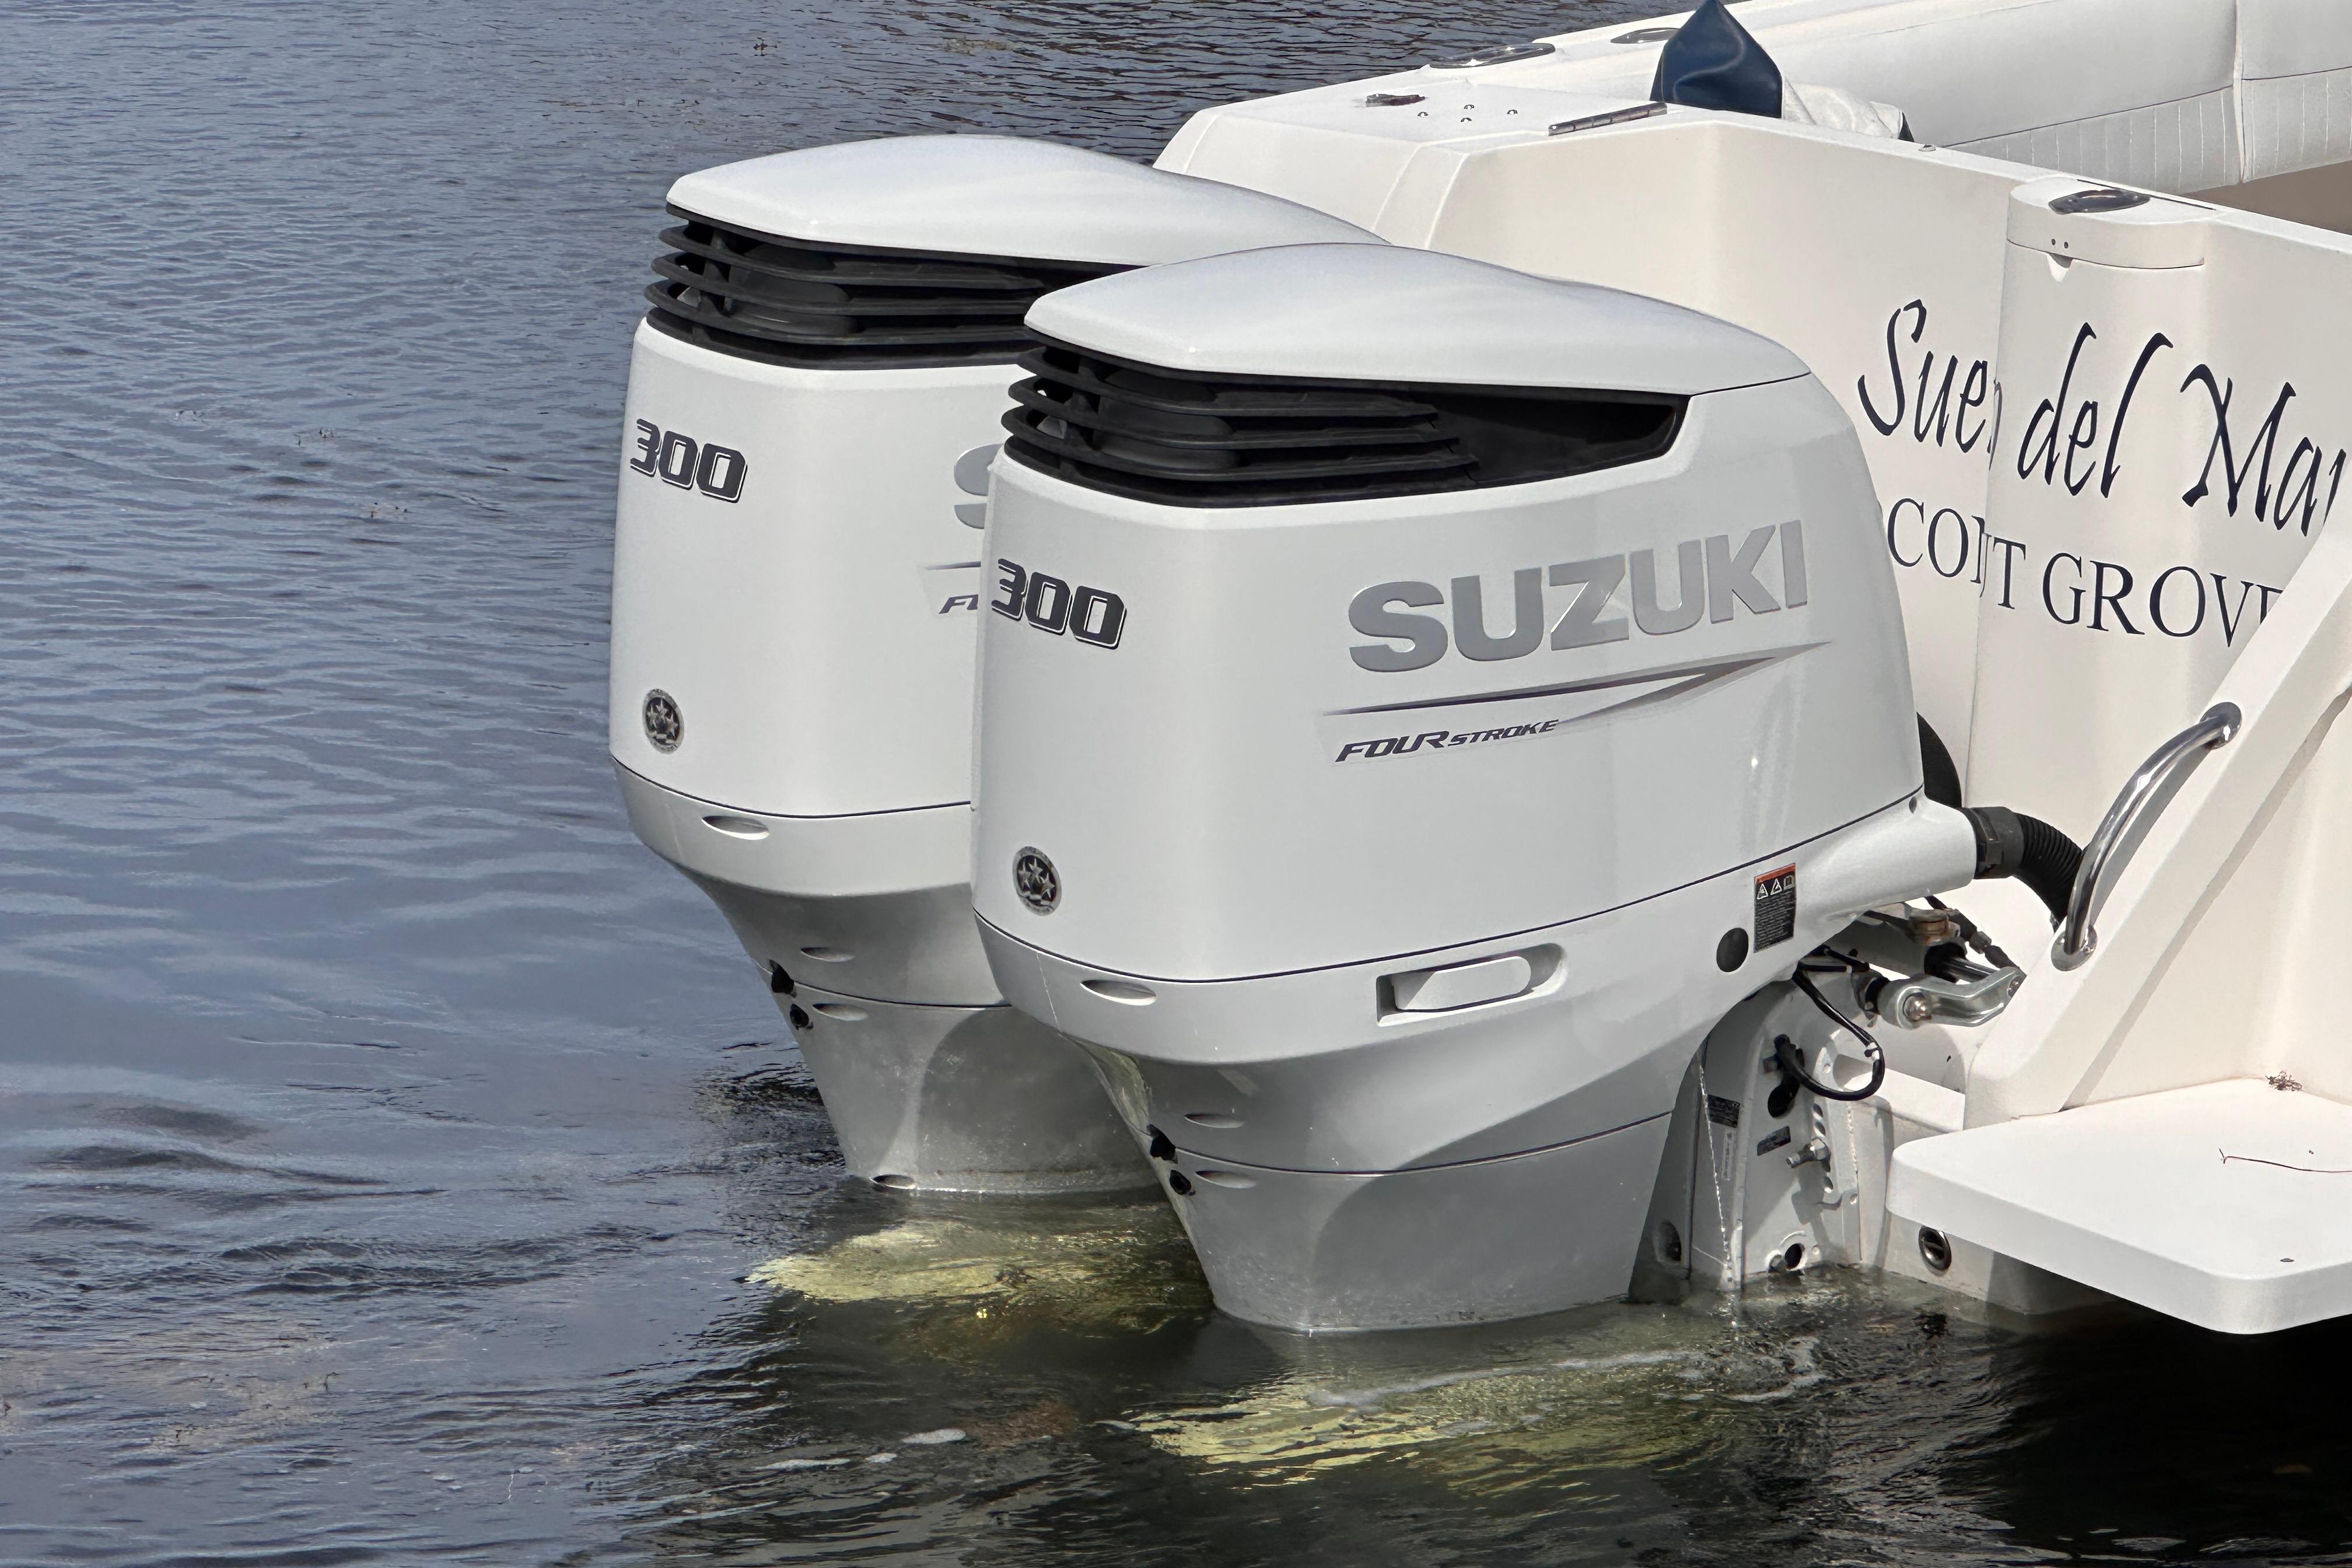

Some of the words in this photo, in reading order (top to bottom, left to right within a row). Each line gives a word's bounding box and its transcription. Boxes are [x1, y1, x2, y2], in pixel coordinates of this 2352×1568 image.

[1857, 299, 2003, 470] Sue
[2017, 322, 2174, 498] del
[629, 418, 748, 504] 300
[991, 558, 1128, 650] 300
[1348, 519, 1808, 673] SUZUKI
